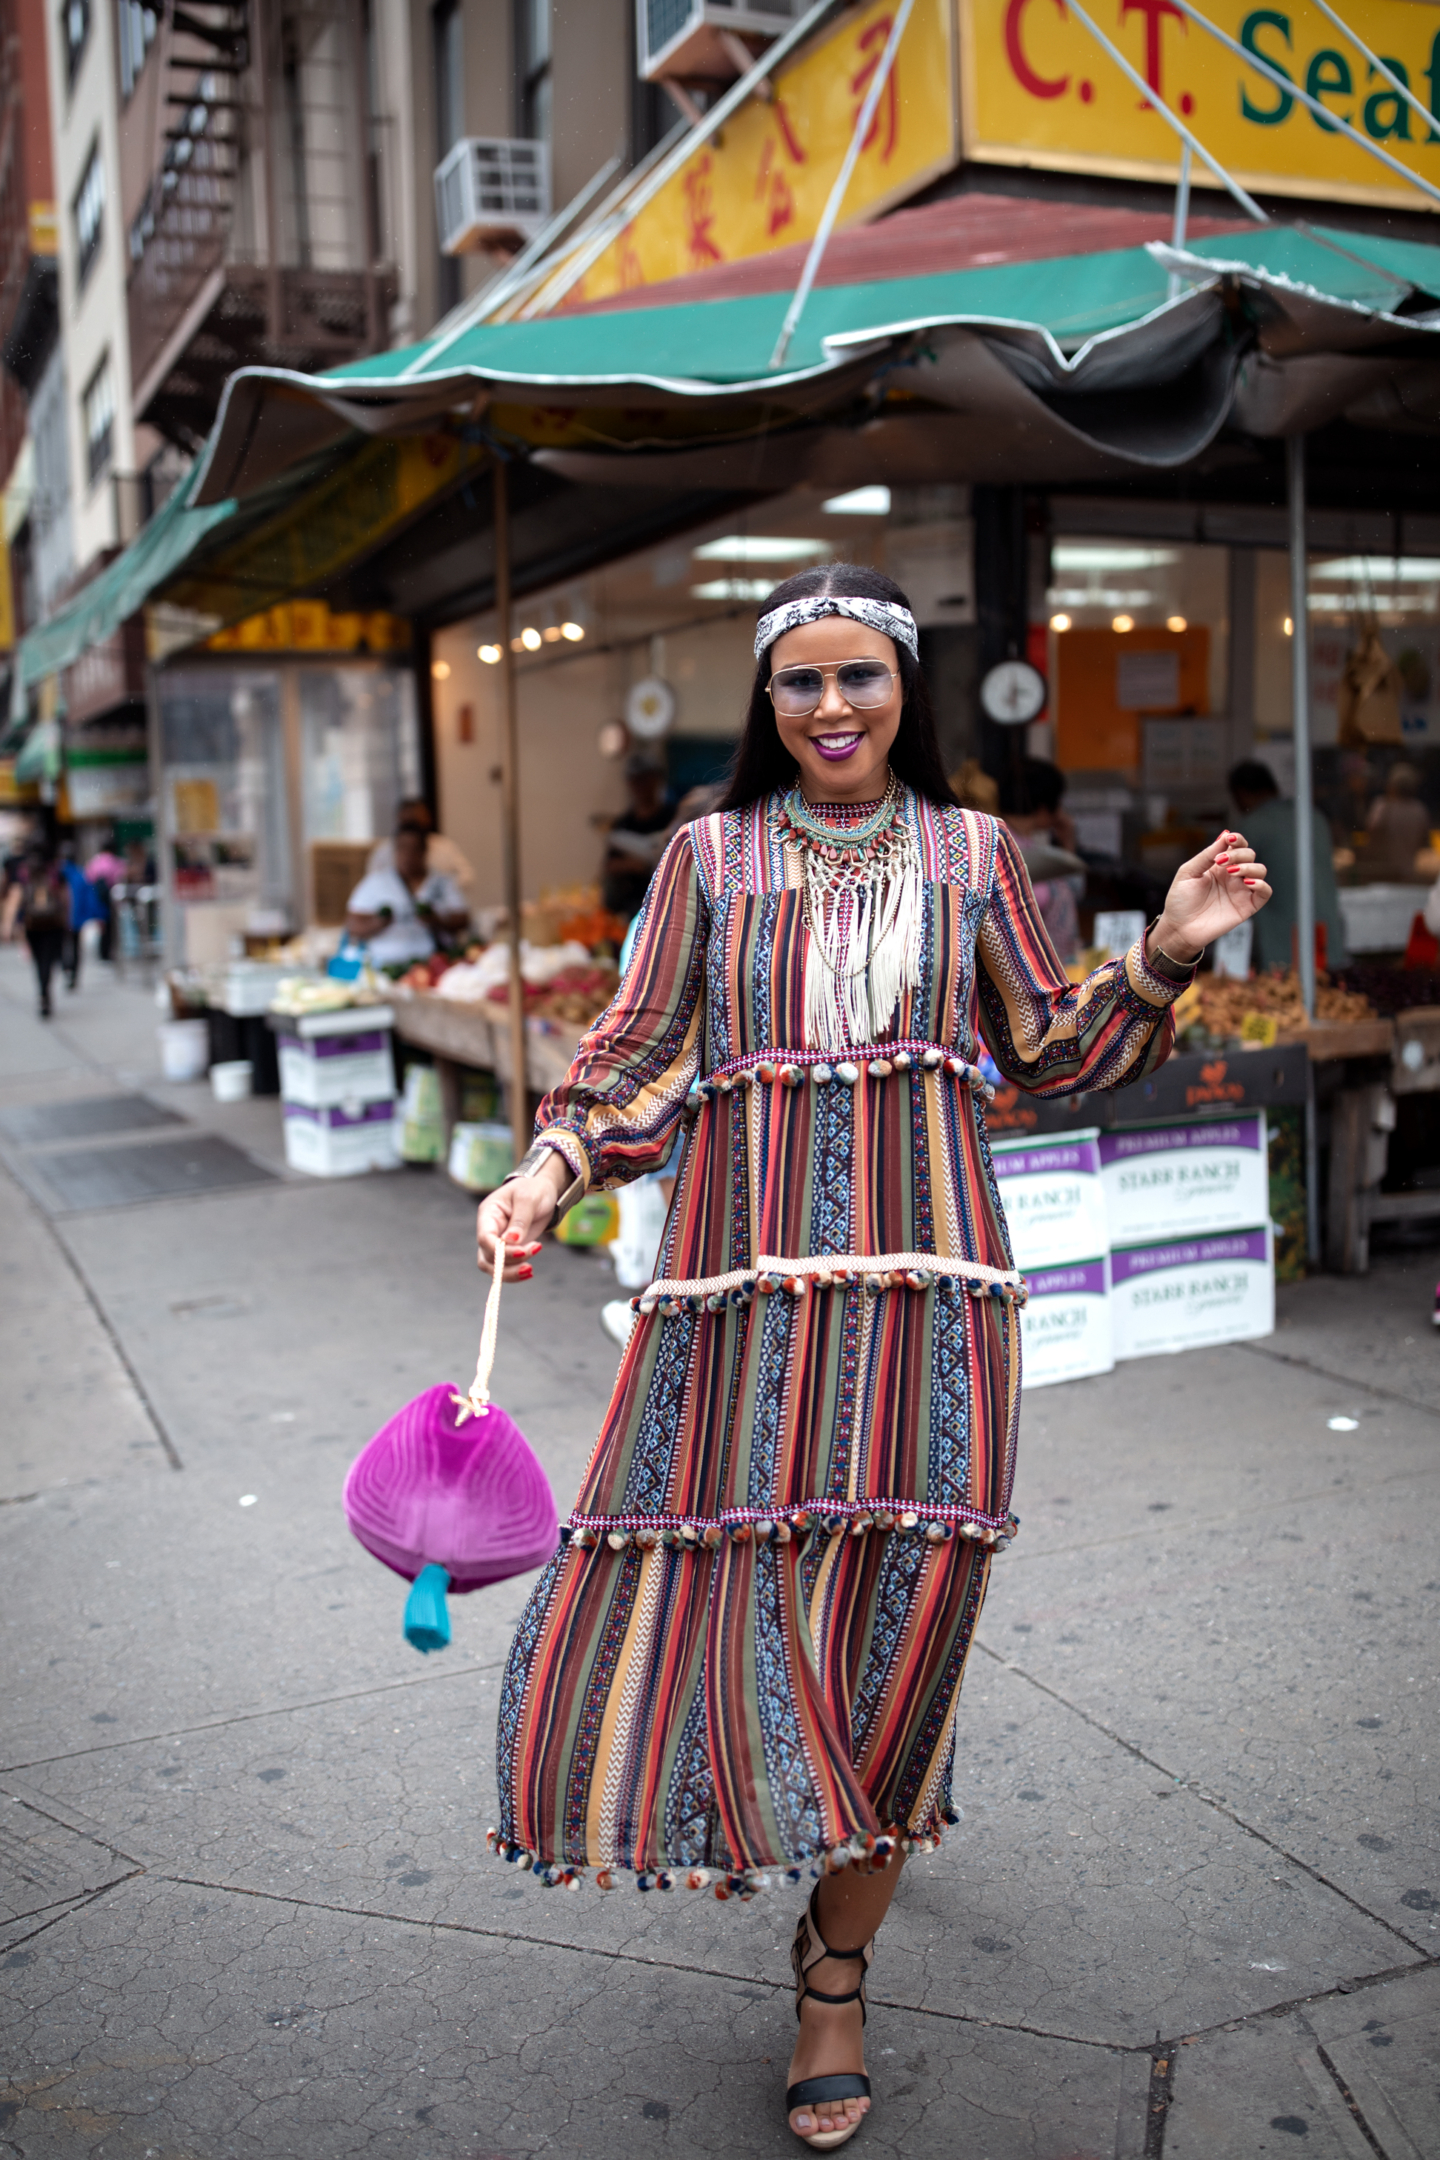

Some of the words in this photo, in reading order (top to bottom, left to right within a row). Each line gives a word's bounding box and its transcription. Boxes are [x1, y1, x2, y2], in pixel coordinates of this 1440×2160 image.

[1117, 1130, 1187, 1152] PREMIUM
[1190, 1125, 1241, 1145] APPLES
[1029, 1149, 1080, 1169] APPLES
[1119, 1167, 1174, 1191] STARR
[1178, 1161, 1240, 1181] RANCH
[1018, 1186, 1081, 1208] RANCH
[1129, 1247, 1199, 1271] PREMIUM
[1201, 1239, 1249, 1259] APPLES
[1036, 1271, 1087, 1291] APPLES
[1132, 1282, 1185, 1307] STARR
[1189, 1273, 1249, 1295] RANCH
[1026, 1307, 1088, 1332] RANCH
